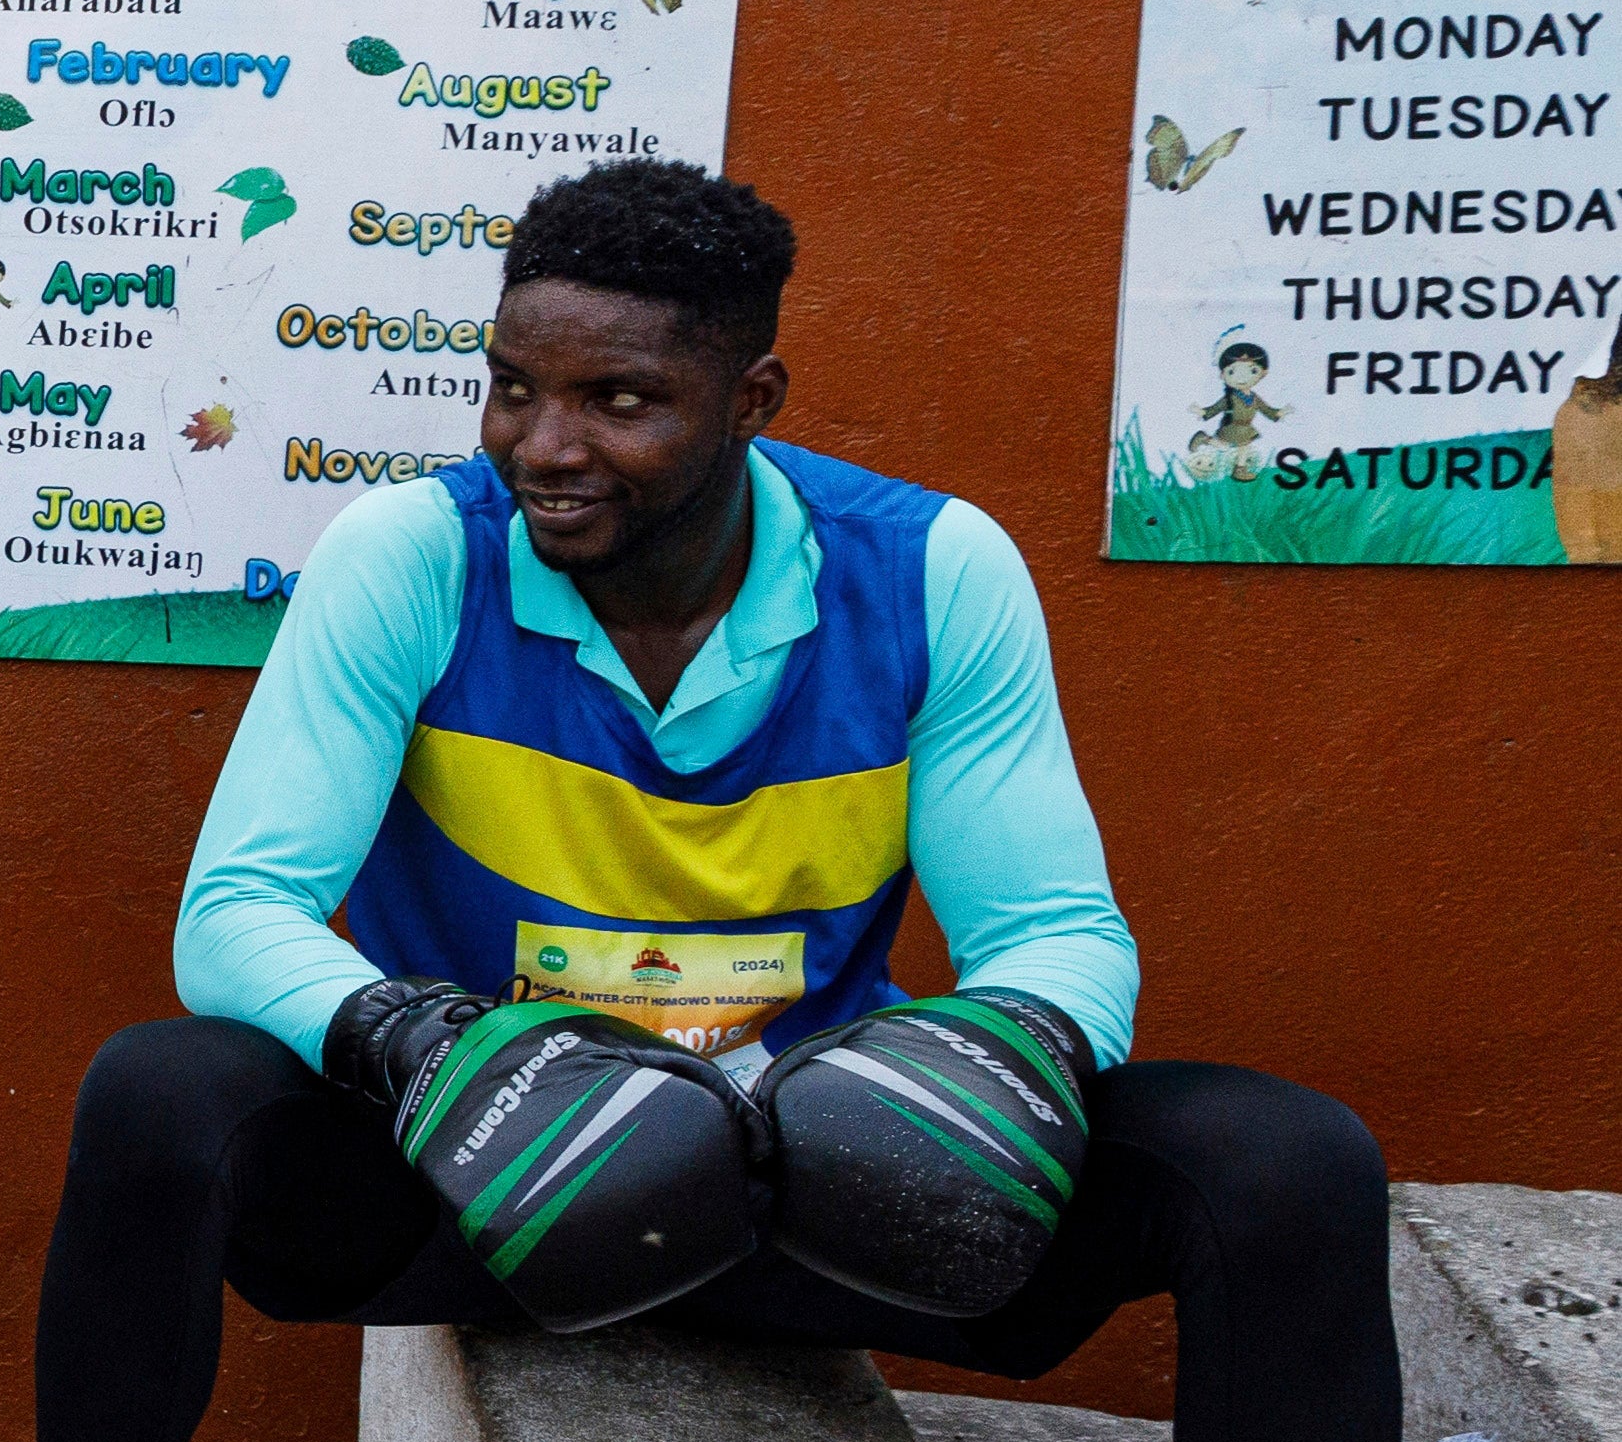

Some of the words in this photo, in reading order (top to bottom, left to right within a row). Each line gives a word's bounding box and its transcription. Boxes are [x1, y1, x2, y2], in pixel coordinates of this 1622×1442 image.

[1335, 12, 1605, 61] MONDAY
[26, 39, 291, 99] February
[398, 63, 612, 117] August
[441, 122, 660, 159] Manyawale
[1318, 91, 1612, 142] TUESDAY
[0, 158, 176, 208] March
[24, 208, 218, 240] Otsokrikri
[349, 199, 515, 256] Septe
[1263, 188, 1622, 237] WEDNESDA
[42, 260, 176, 315] April
[1283, 273, 1622, 321] THURSDAY
[1325, 350, 1565, 396] FRIDAY
[0, 370, 112, 426] May
[1272, 444, 1555, 492] SATURDA
[33, 486, 166, 535] June
[540, 952, 565, 965] 21K
[732, 959, 785, 974] (2024)
[581, 992, 648, 1006] INTER-CITY
[651, 996, 710, 1007] HOMOWO
